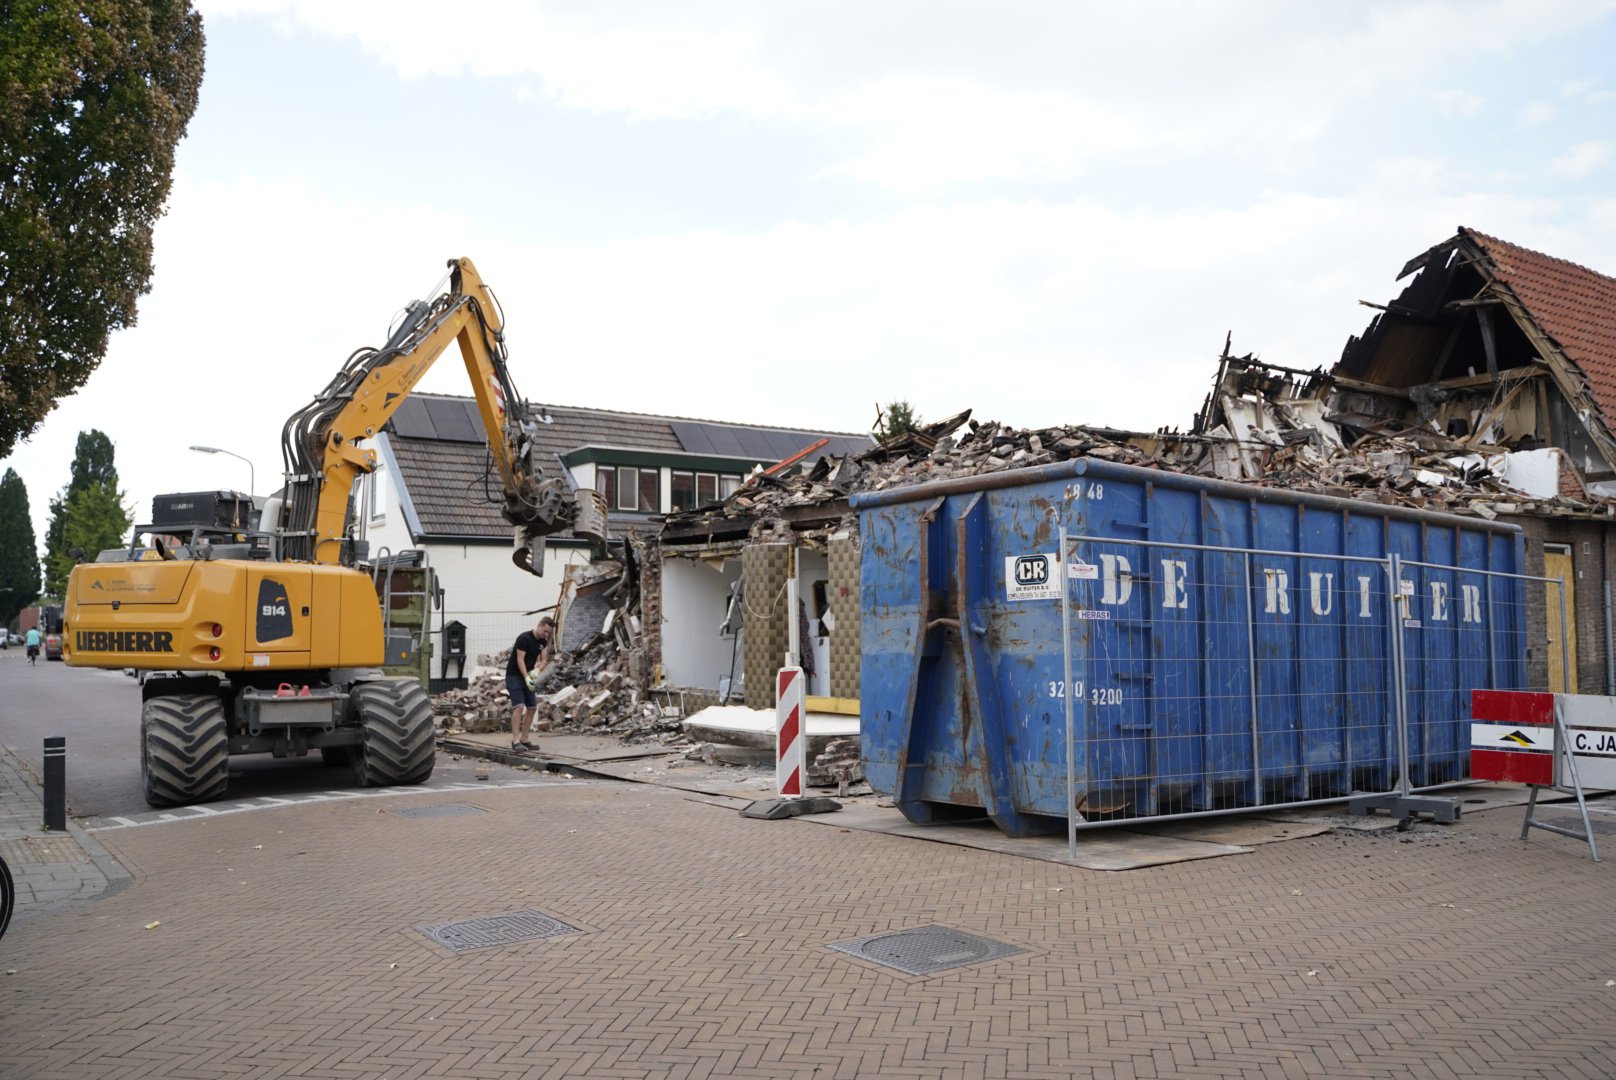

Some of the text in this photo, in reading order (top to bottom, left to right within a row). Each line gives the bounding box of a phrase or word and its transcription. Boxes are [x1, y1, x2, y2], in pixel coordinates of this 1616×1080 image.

[1087, 482, 1104, 500] 48
[1099, 553, 1189, 609] DE
[262, 605, 287, 616] 914
[1081, 611, 1106, 619] HERAS
[76, 631, 174, 652] LIEBHERR
[1048, 681, 1083, 698] 320
[1091, 688, 1123, 706] 3200
[1575, 733, 1591, 751] C.
